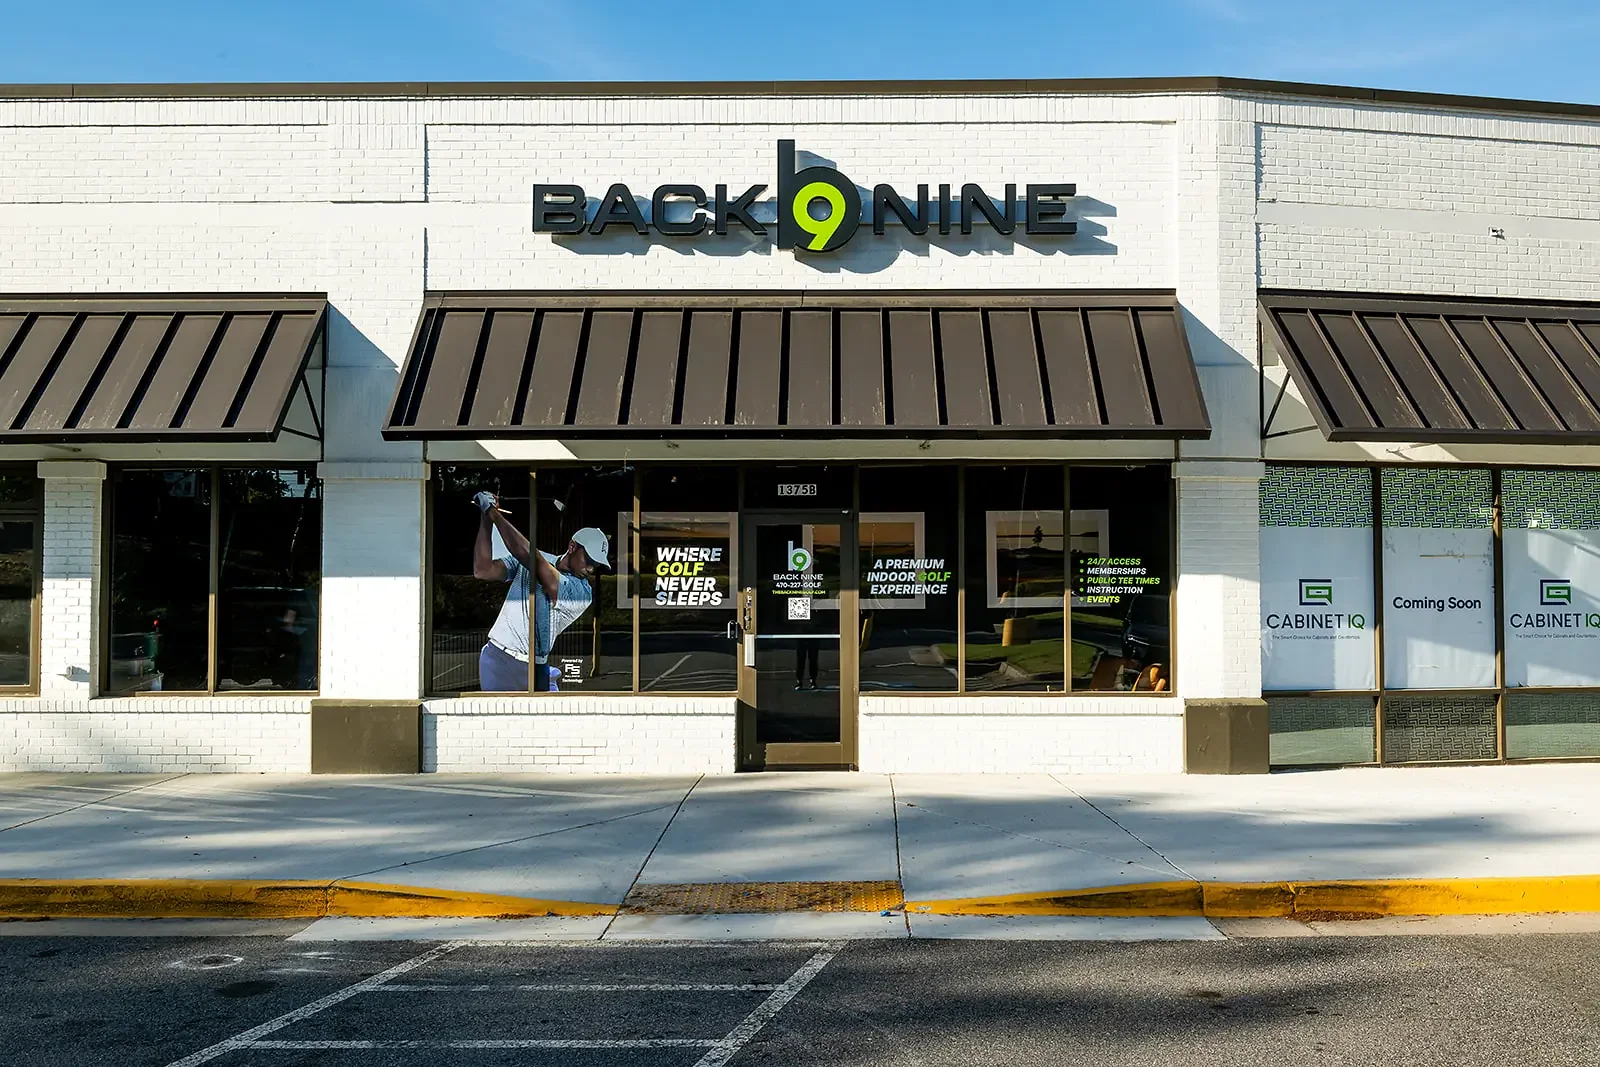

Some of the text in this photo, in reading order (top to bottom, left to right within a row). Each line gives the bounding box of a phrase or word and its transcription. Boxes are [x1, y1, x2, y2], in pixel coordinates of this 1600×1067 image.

[533, 183, 768, 235] BACK
[873, 183, 1077, 235] NINE
[657, 547, 722, 561] WHERE
[656, 562, 705, 576] GOLF
[873, 559, 945, 569] A PREMIUM
[1087, 567, 1147, 575] MEMBERSHIPS
[655, 577, 716, 591] NEVER
[867, 572, 951, 582] INDOOR GOLF
[1135, 577, 1160, 585] TIMES
[870, 584, 948, 594] EXPERIENCE
[1087, 586, 1143, 594] INSTRUCTION
[655, 592, 723, 606] SLEEPS
[1087, 595, 1120, 603] EVENTS
[1393, 596, 1481, 612] Coming Soon
[1266, 614, 1365, 630] CABINET IQ
[1510, 613, 1600, 628] CABINET IQ
